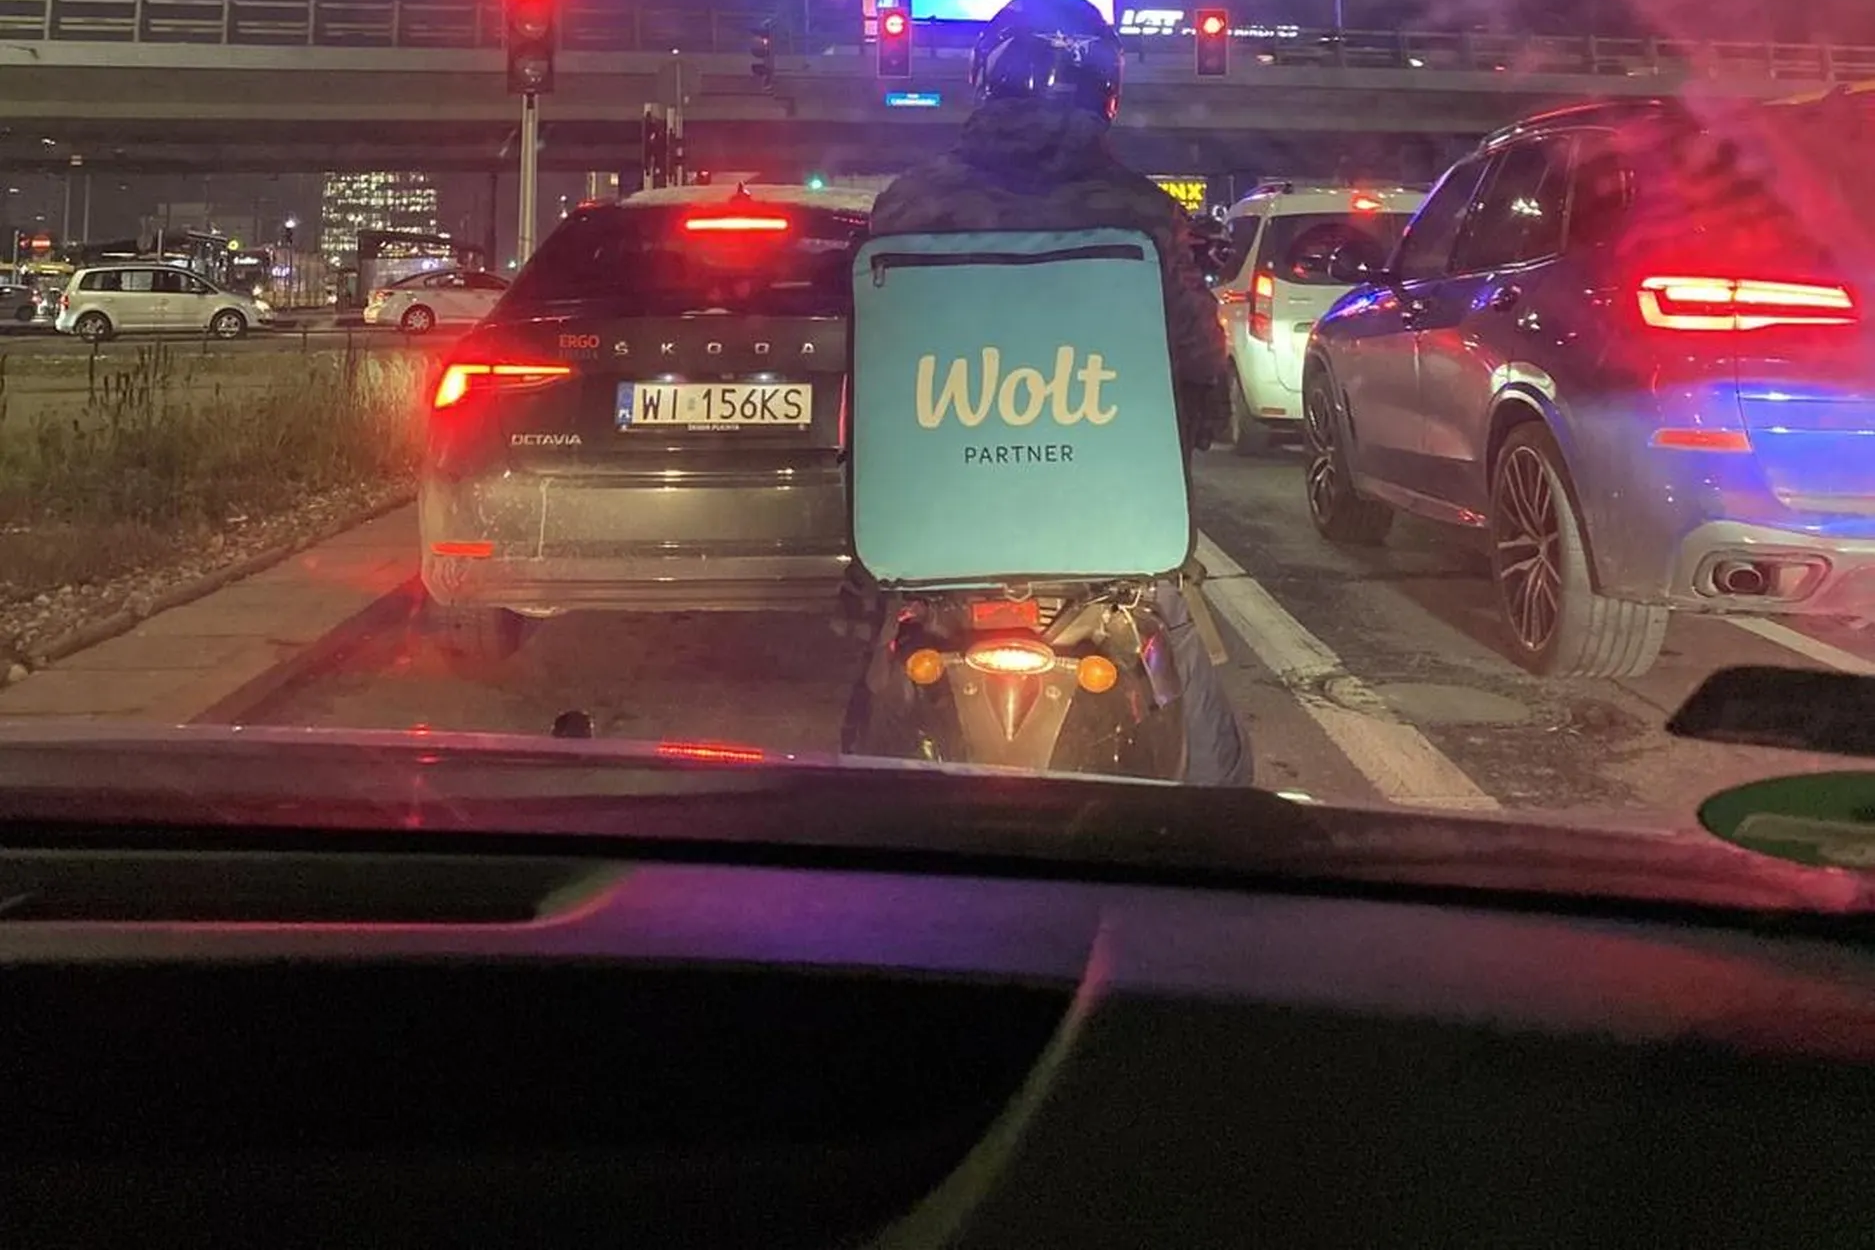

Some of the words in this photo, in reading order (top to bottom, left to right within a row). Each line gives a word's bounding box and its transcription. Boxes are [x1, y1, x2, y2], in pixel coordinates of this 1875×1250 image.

[559, 334, 600, 348] ERGO
[915, 345, 1118, 429] Wolt
[641, 388, 678, 421] WI
[702, 388, 803, 421] 156KS
[510, 433, 582, 446] OCTAVIA
[964, 444, 1074, 464] PARTNER
